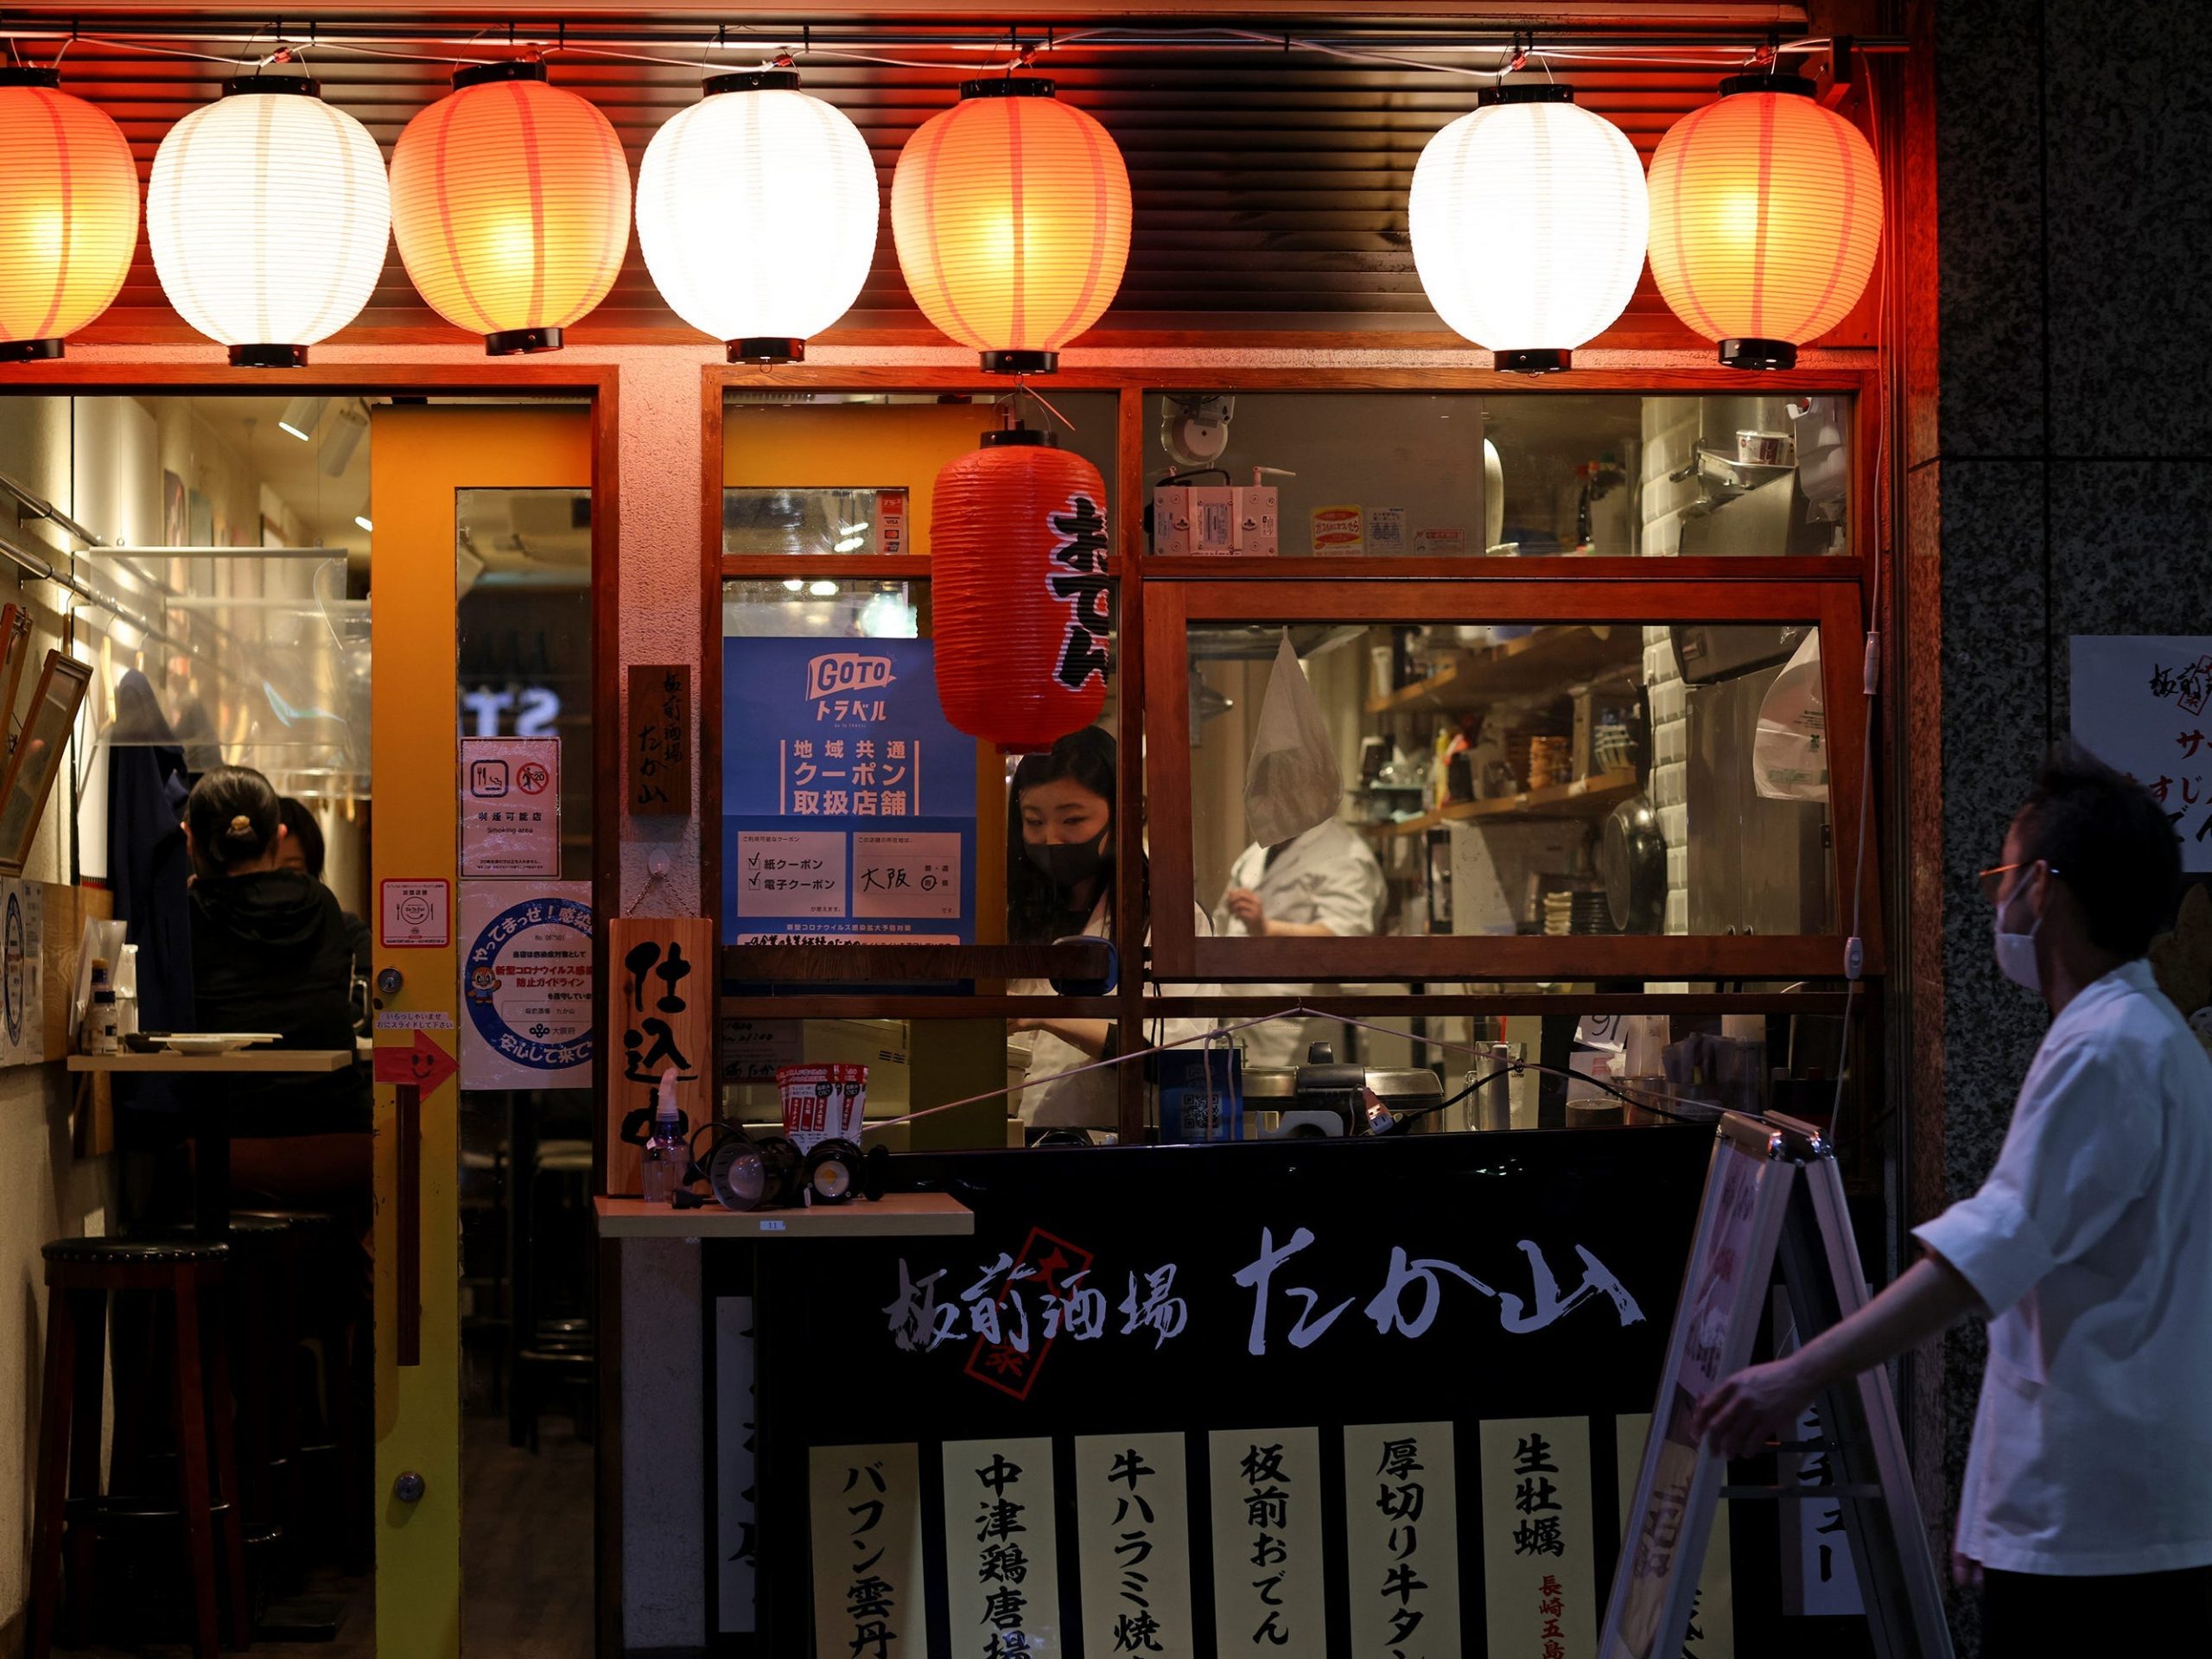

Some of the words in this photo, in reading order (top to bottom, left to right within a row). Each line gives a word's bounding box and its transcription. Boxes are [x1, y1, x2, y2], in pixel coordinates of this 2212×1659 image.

[817, 700, 887, 721] トラベル
[793, 740, 906, 759] 地域共通
[638, 725, 669, 804] たか山
[793, 762, 906, 786] クーポン
[793, 790, 906, 815] 取扱店舗
[764, 859, 823, 870] 紙クーポン
[764, 879, 836, 890] 電子クーポン
[861, 868, 911, 893] 大阪
[473, 906, 592, 963] やってまっせ！感染
[516, 978, 585, 988] 防止ガイドライン
[881, 1252, 1188, 1354] 板前酒場
[1231, 1225, 1647, 1357] たか山
[1107, 1448, 1164, 1659] 牛ハラミ焼
[1239, 1444, 1293, 1646] 板前おでん
[842, 1460, 897, 1659] バフン雲丹
